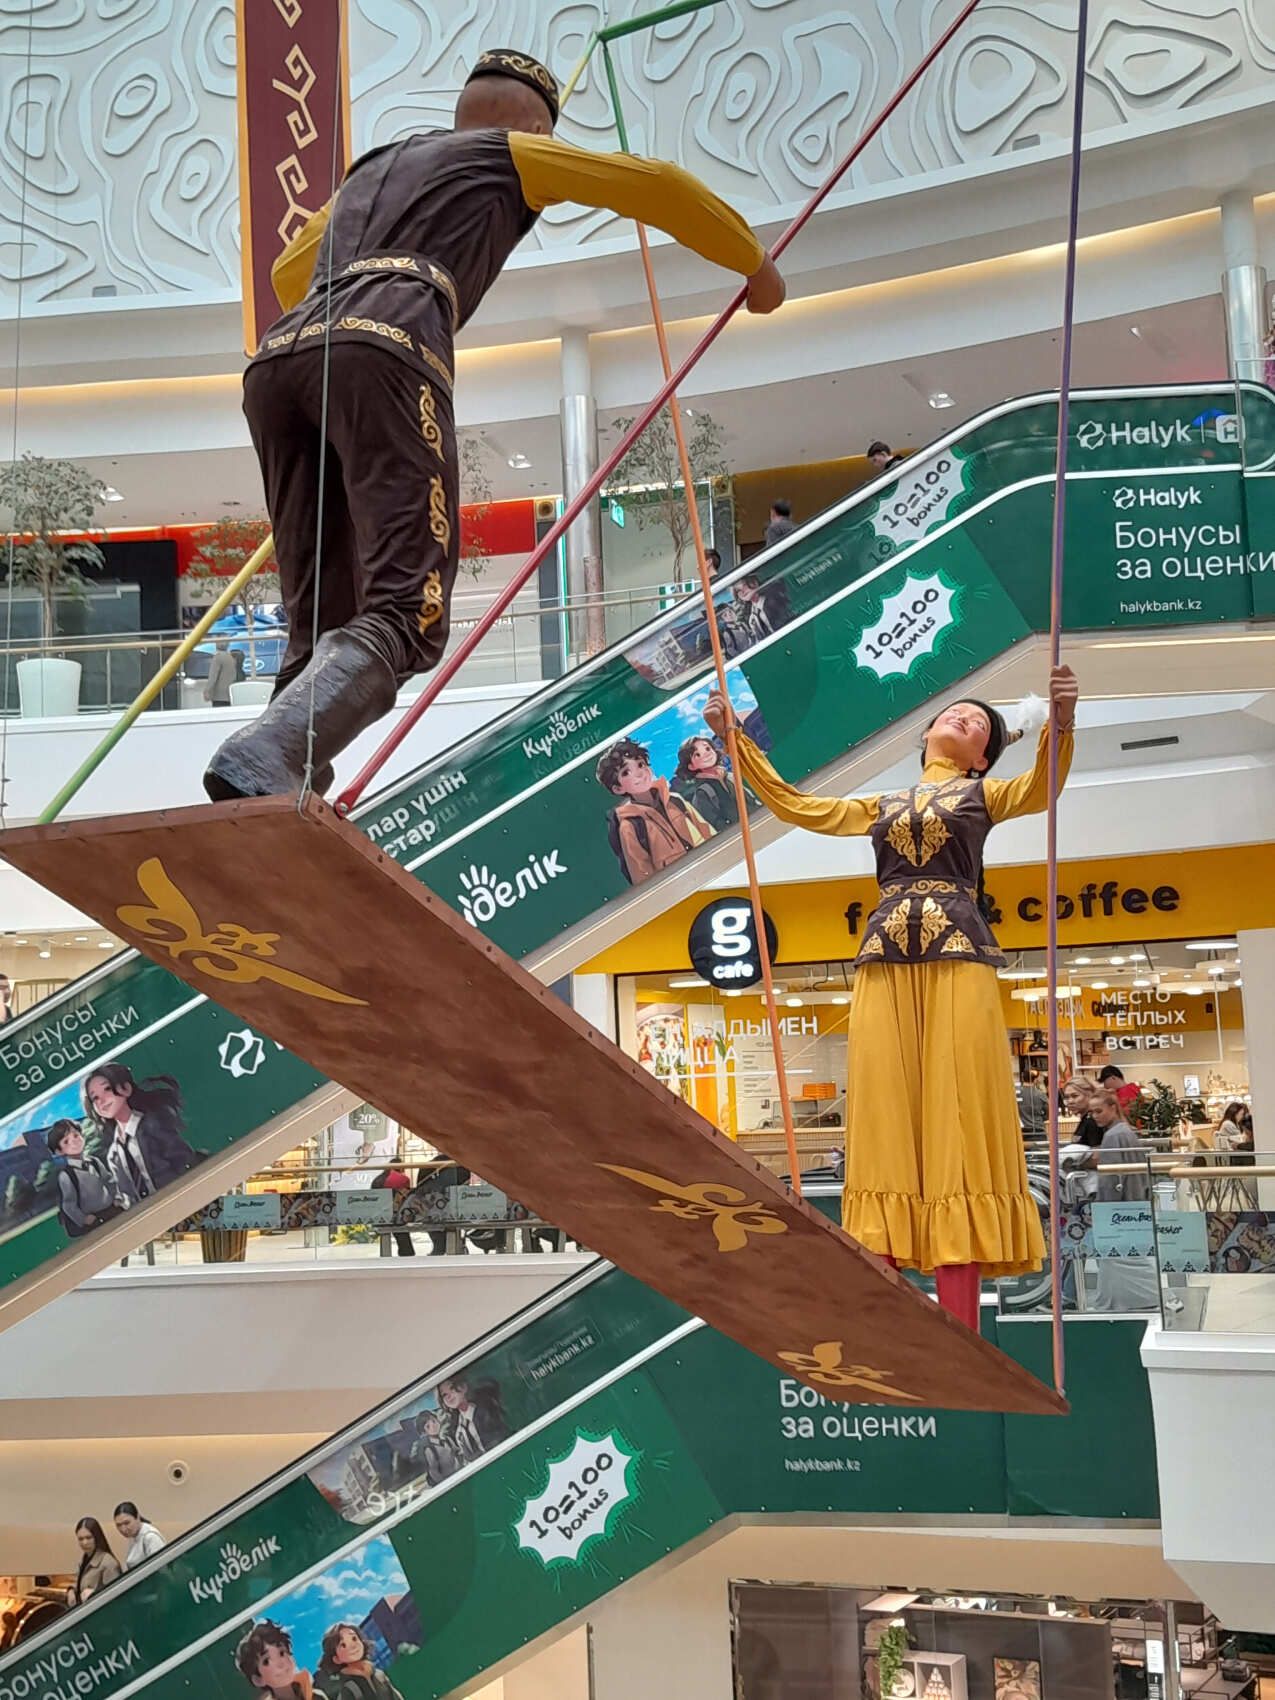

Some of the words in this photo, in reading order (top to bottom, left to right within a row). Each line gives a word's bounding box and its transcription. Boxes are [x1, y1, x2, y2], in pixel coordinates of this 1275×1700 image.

[1111, 419, 1192, 447] Halyk
[882, 459, 951, 529] 10=100
[907, 486, 949, 527] bonus
[1139, 486, 1202, 508] Halyk
[1115, 521, 1240, 552] Бонусы
[1116, 556, 1151, 579] за
[1162, 551, 1275, 580] оценки
[1120, 598, 1202, 613] halykbank.kz
[865, 588, 939, 660] 10=100
[890, 616, 936, 659] bonus
[1018, 881, 1180, 922] coffee
[711, 907, 751, 957] g
[712, 960, 754, 979] cafe
[1101, 990, 1171, 1005] МЕСТО
[0, 1001, 97, 1070] Бонусы
[1103, 1010, 1186, 1027] ТЁПЛЫХ
[15, 1065, 46, 1091] за
[48, 1005, 140, 1070] оценки
[1105, 1034, 1184, 1050] ВСТРЕЧ
[781, 1416, 814, 1438] за
[823, 1416, 937, 1441] оценки
[529, 1453, 613, 1539] 10=100
[557, 1488, 608, 1540] bonus
